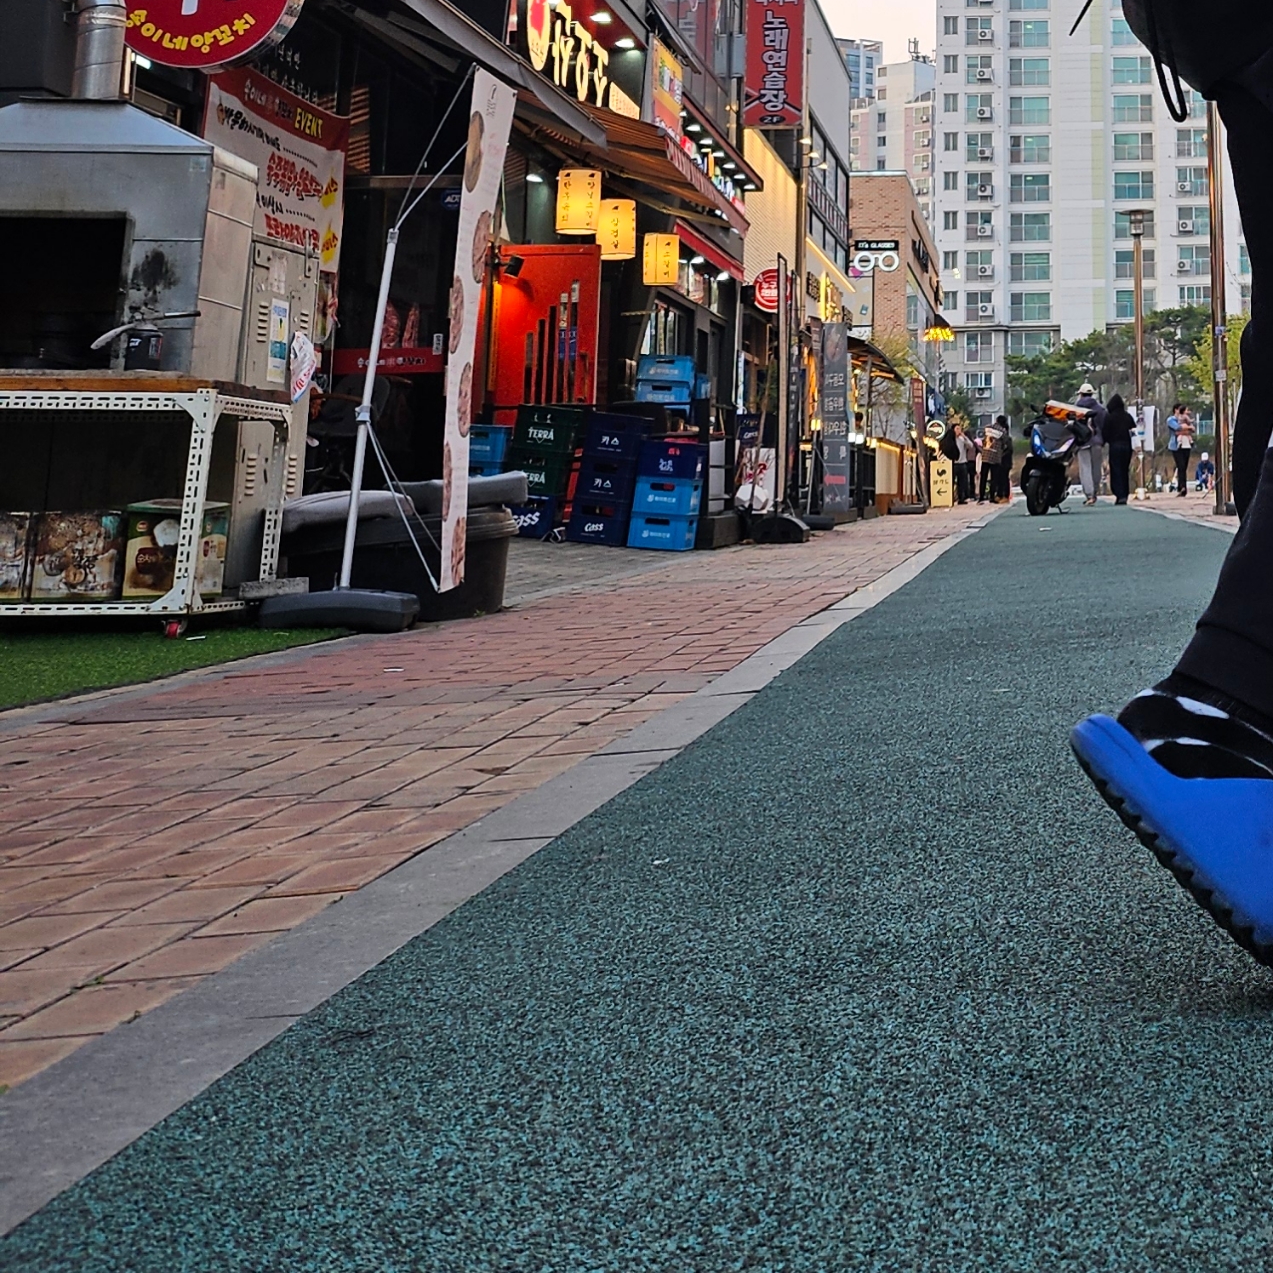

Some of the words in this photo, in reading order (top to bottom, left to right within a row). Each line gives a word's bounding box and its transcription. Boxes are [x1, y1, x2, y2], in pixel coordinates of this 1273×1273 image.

[760, 10, 789, 112] 노래연습장
[294, 106, 324, 139] EVENT
[762, 115, 781, 124] 2F
[528, 426, 554, 441] TERRA
[522, 469, 546, 484] ERRA
[584, 523, 604, 532] Cass
